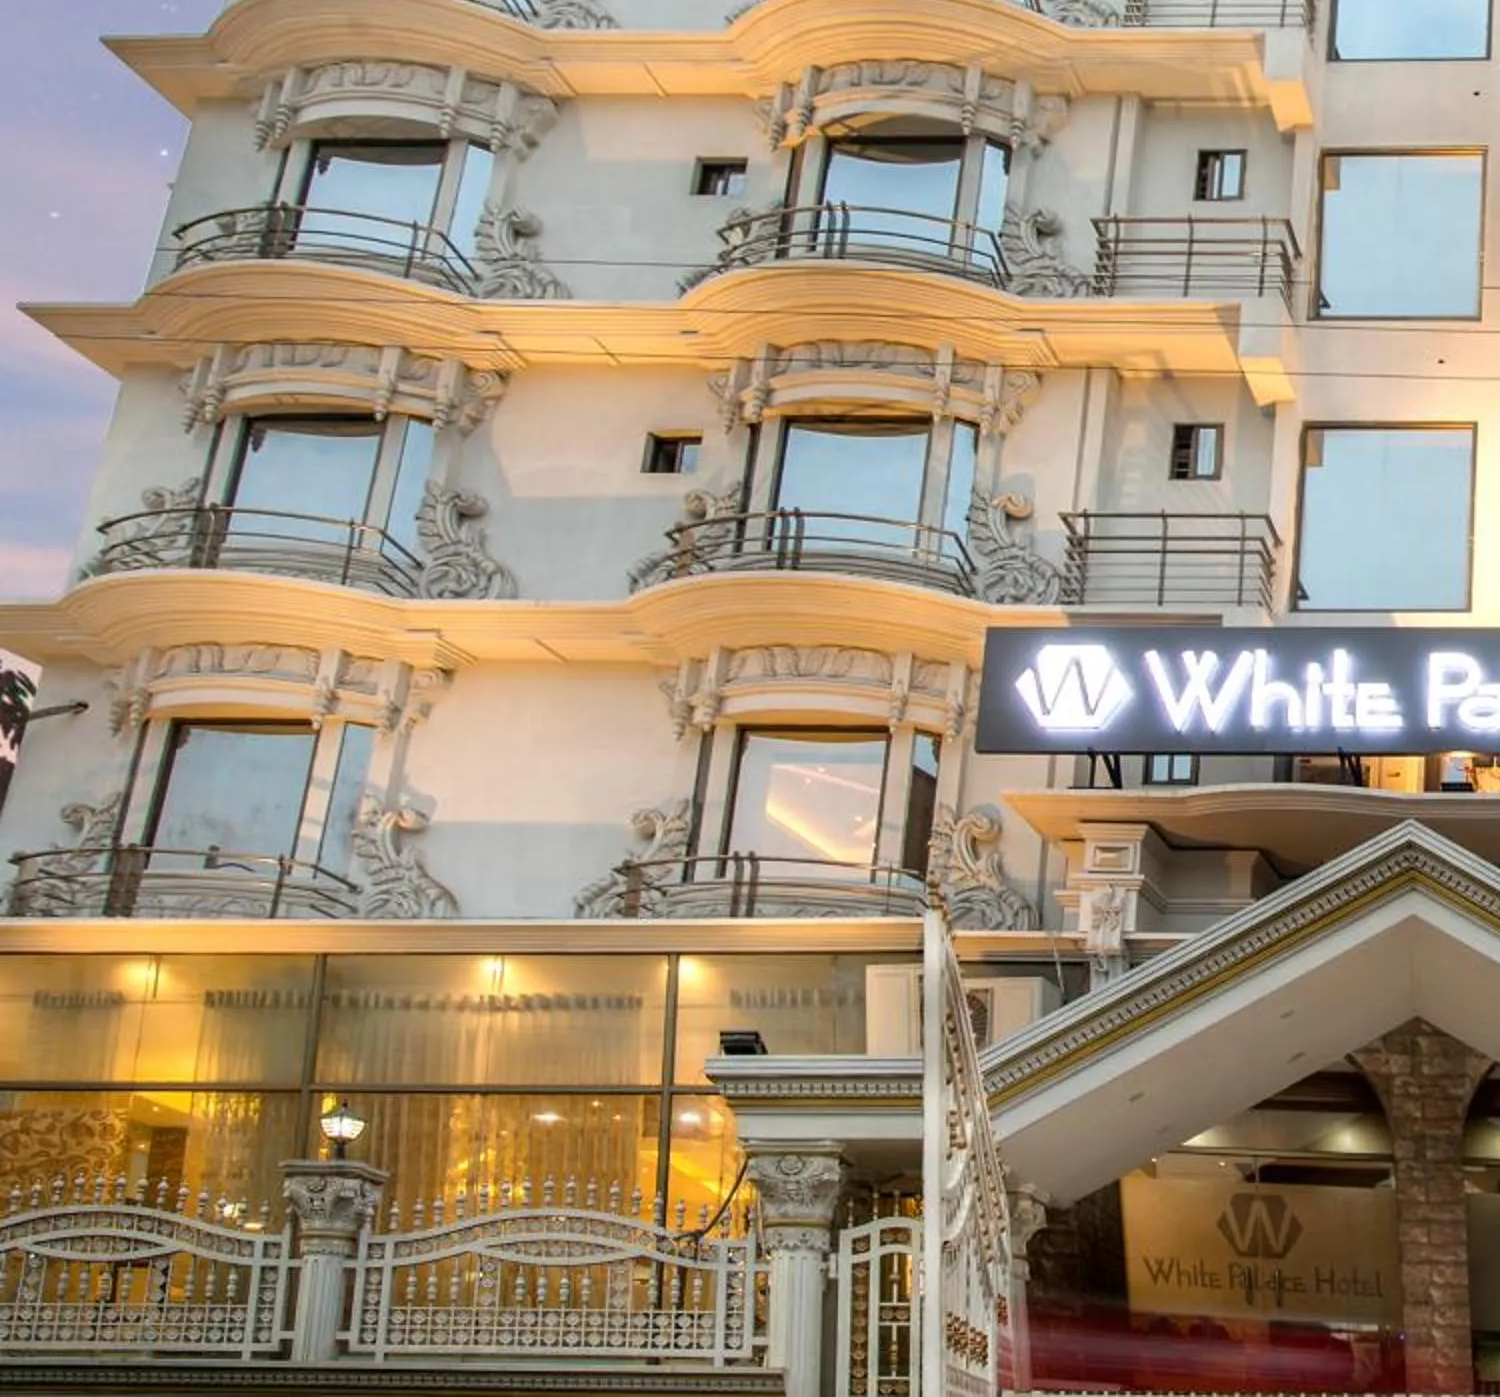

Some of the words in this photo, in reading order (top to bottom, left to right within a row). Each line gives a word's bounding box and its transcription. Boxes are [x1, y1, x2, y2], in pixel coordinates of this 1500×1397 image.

[1144, 648, 1404, 732] White
[1143, 1255, 1222, 1290] White
[1314, 1265, 1384, 1297] Hotel
